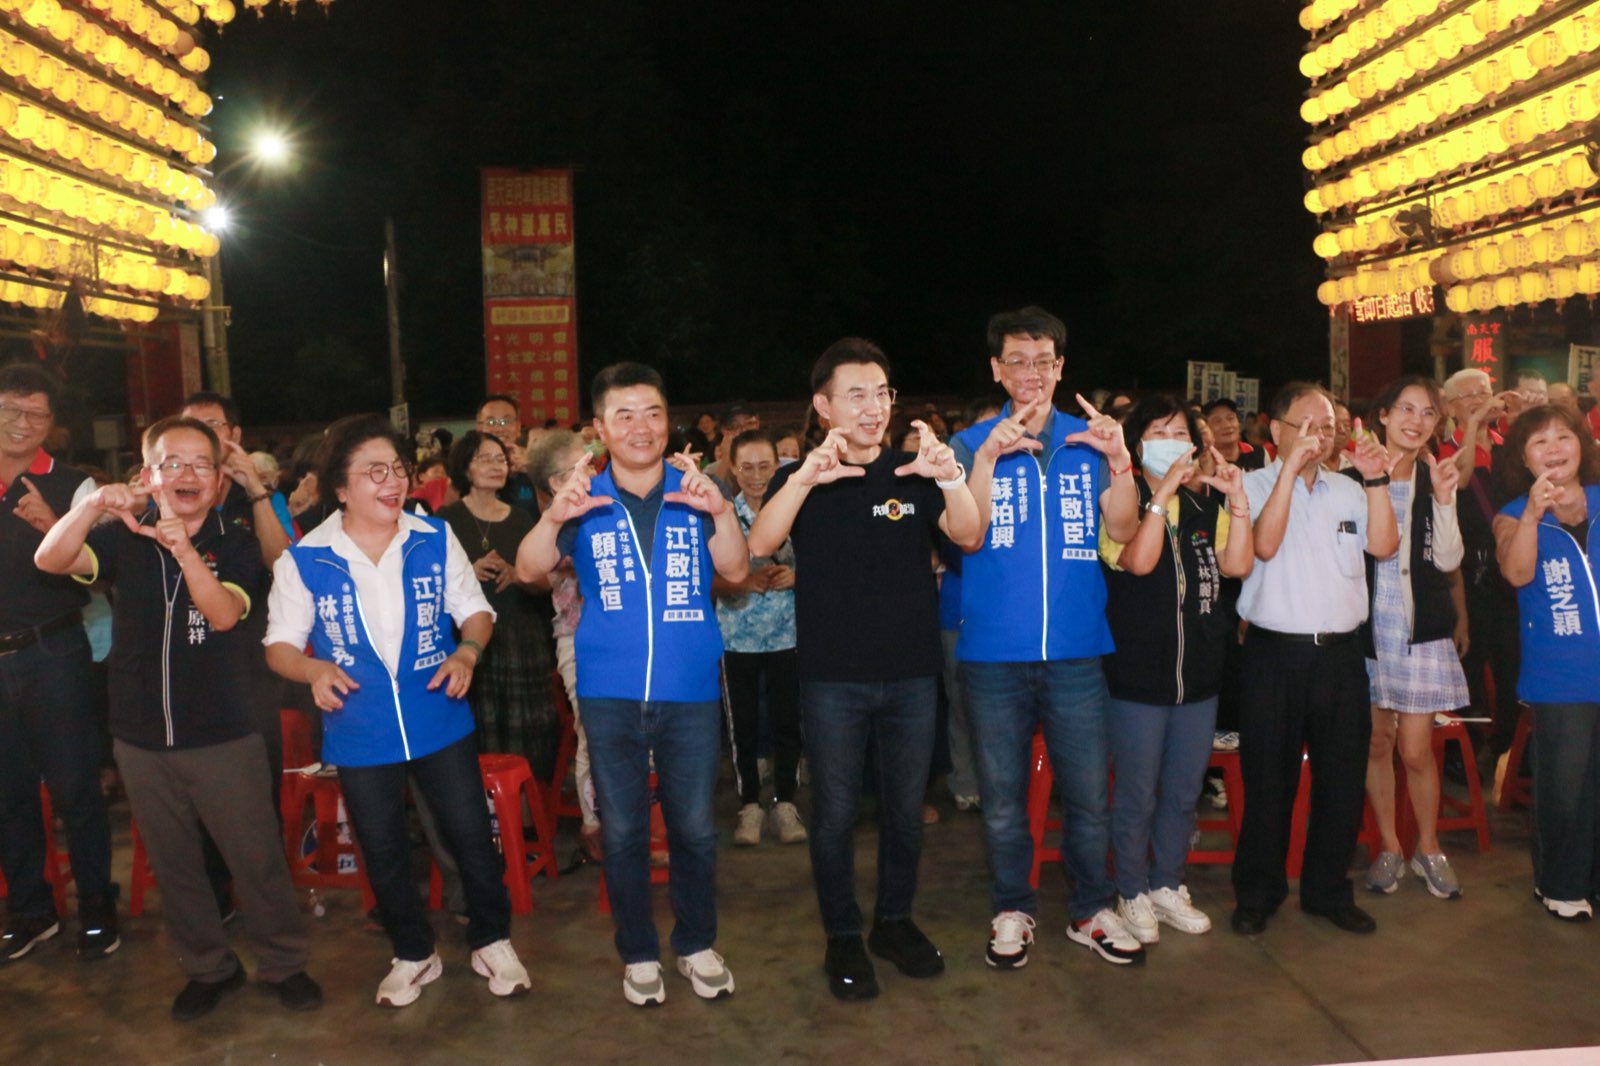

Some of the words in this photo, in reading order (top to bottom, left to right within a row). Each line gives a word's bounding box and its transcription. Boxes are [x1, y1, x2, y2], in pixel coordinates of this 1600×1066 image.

[991, 477, 1015, 549] 蘇柏興
[1059, 473, 1084, 545] 江啟臣
[618, 531, 636, 582] 立法委員
[665, 525, 690, 606] 江啟臣
[188, 605, 206, 645] 原祥
[413, 576, 436, 655] 江啟臣
